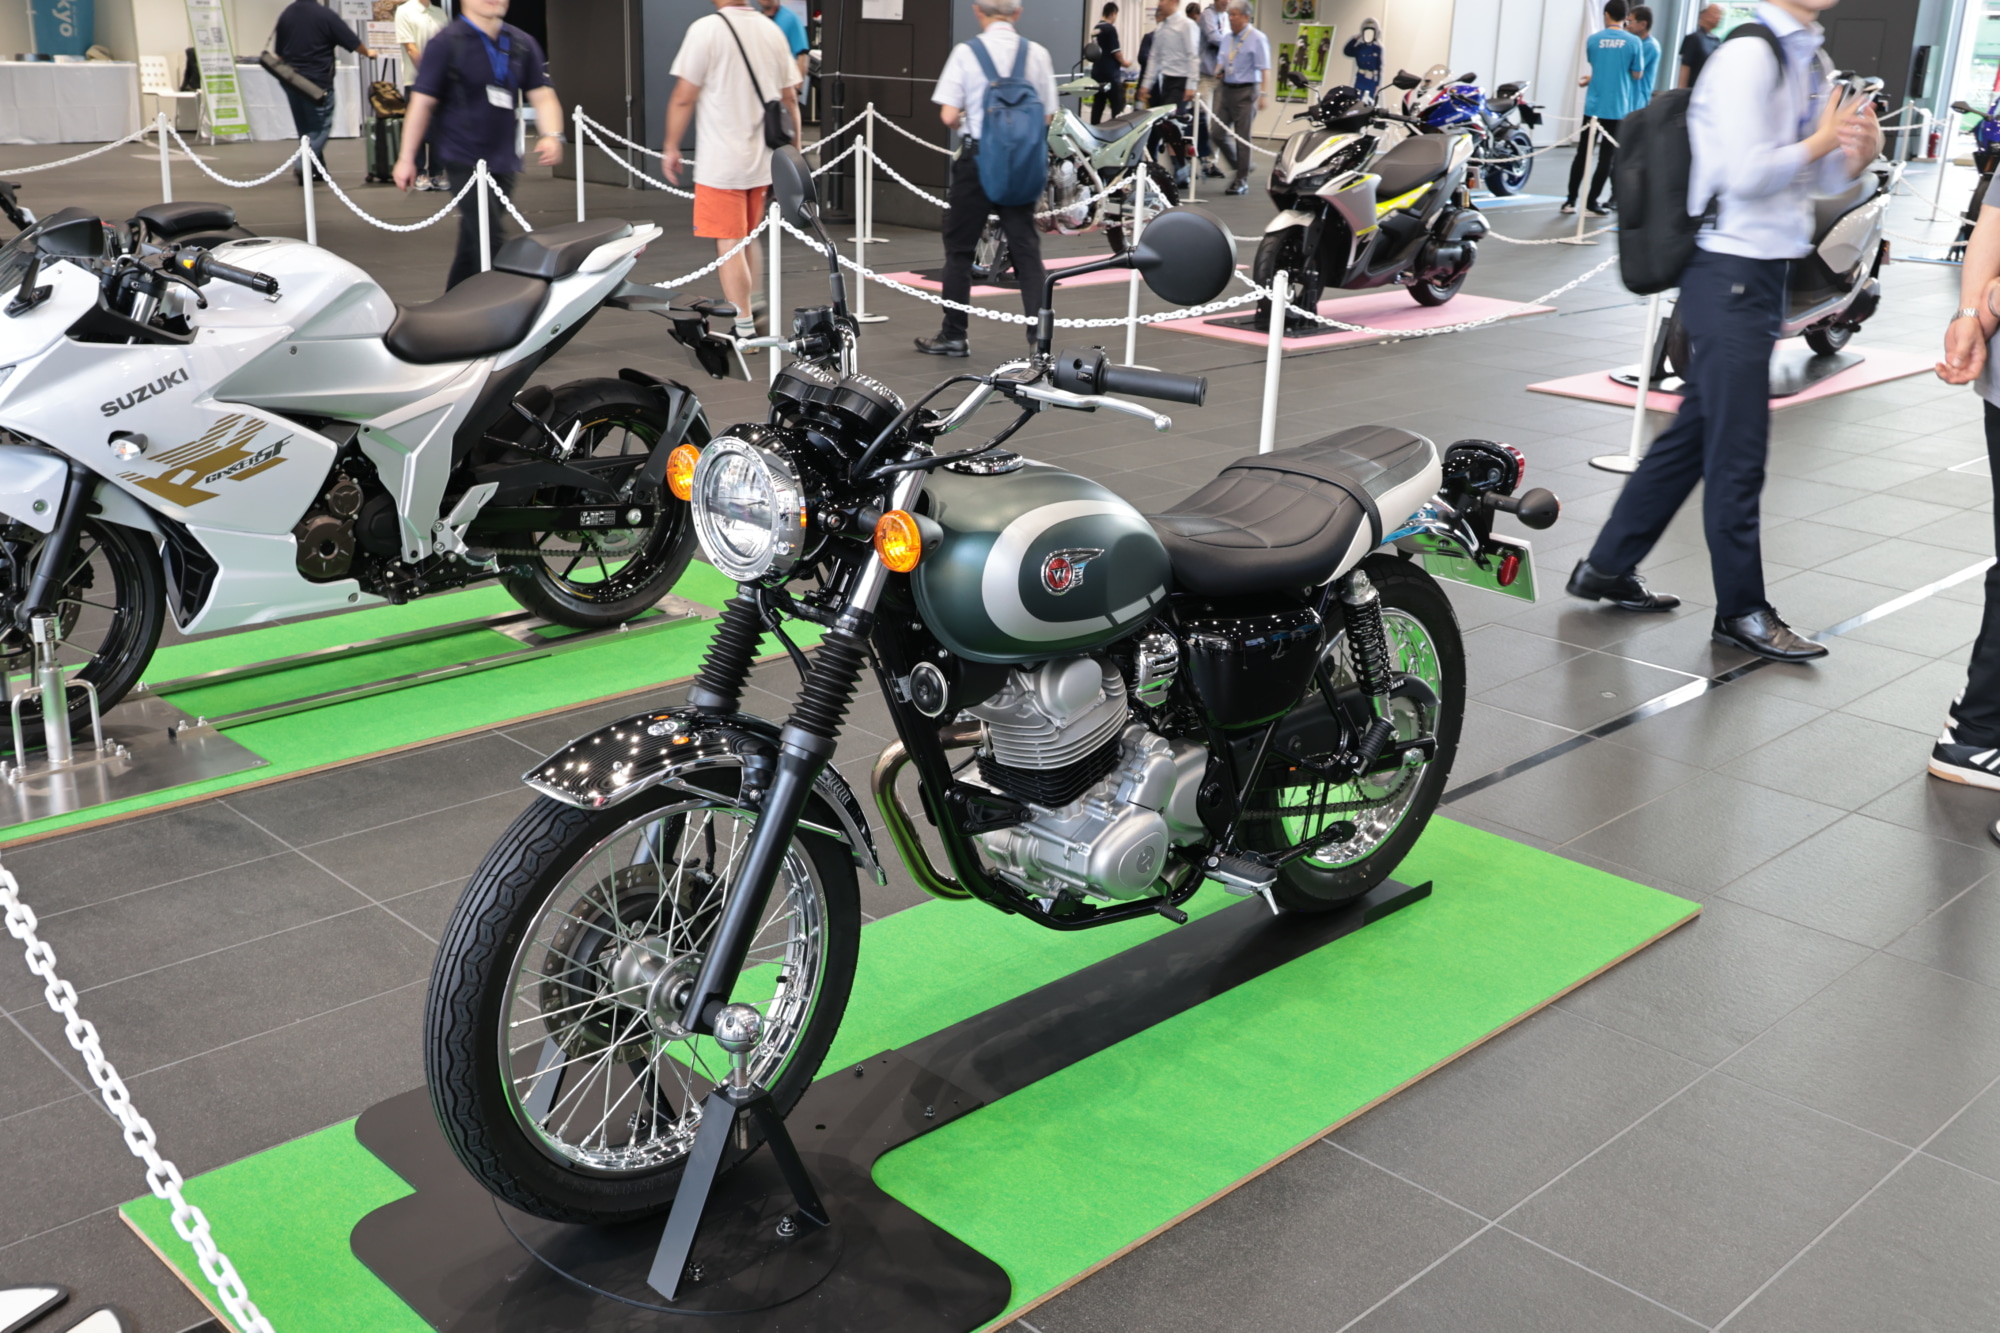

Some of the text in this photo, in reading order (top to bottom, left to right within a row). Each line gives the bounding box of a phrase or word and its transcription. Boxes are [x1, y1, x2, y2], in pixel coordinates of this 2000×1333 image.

[1599, 39, 1626, 48] STAFF
[100, 367, 189, 417] SUZUKI
[253, 433, 294, 467] SF
[1050, 566, 1068, 584] W
